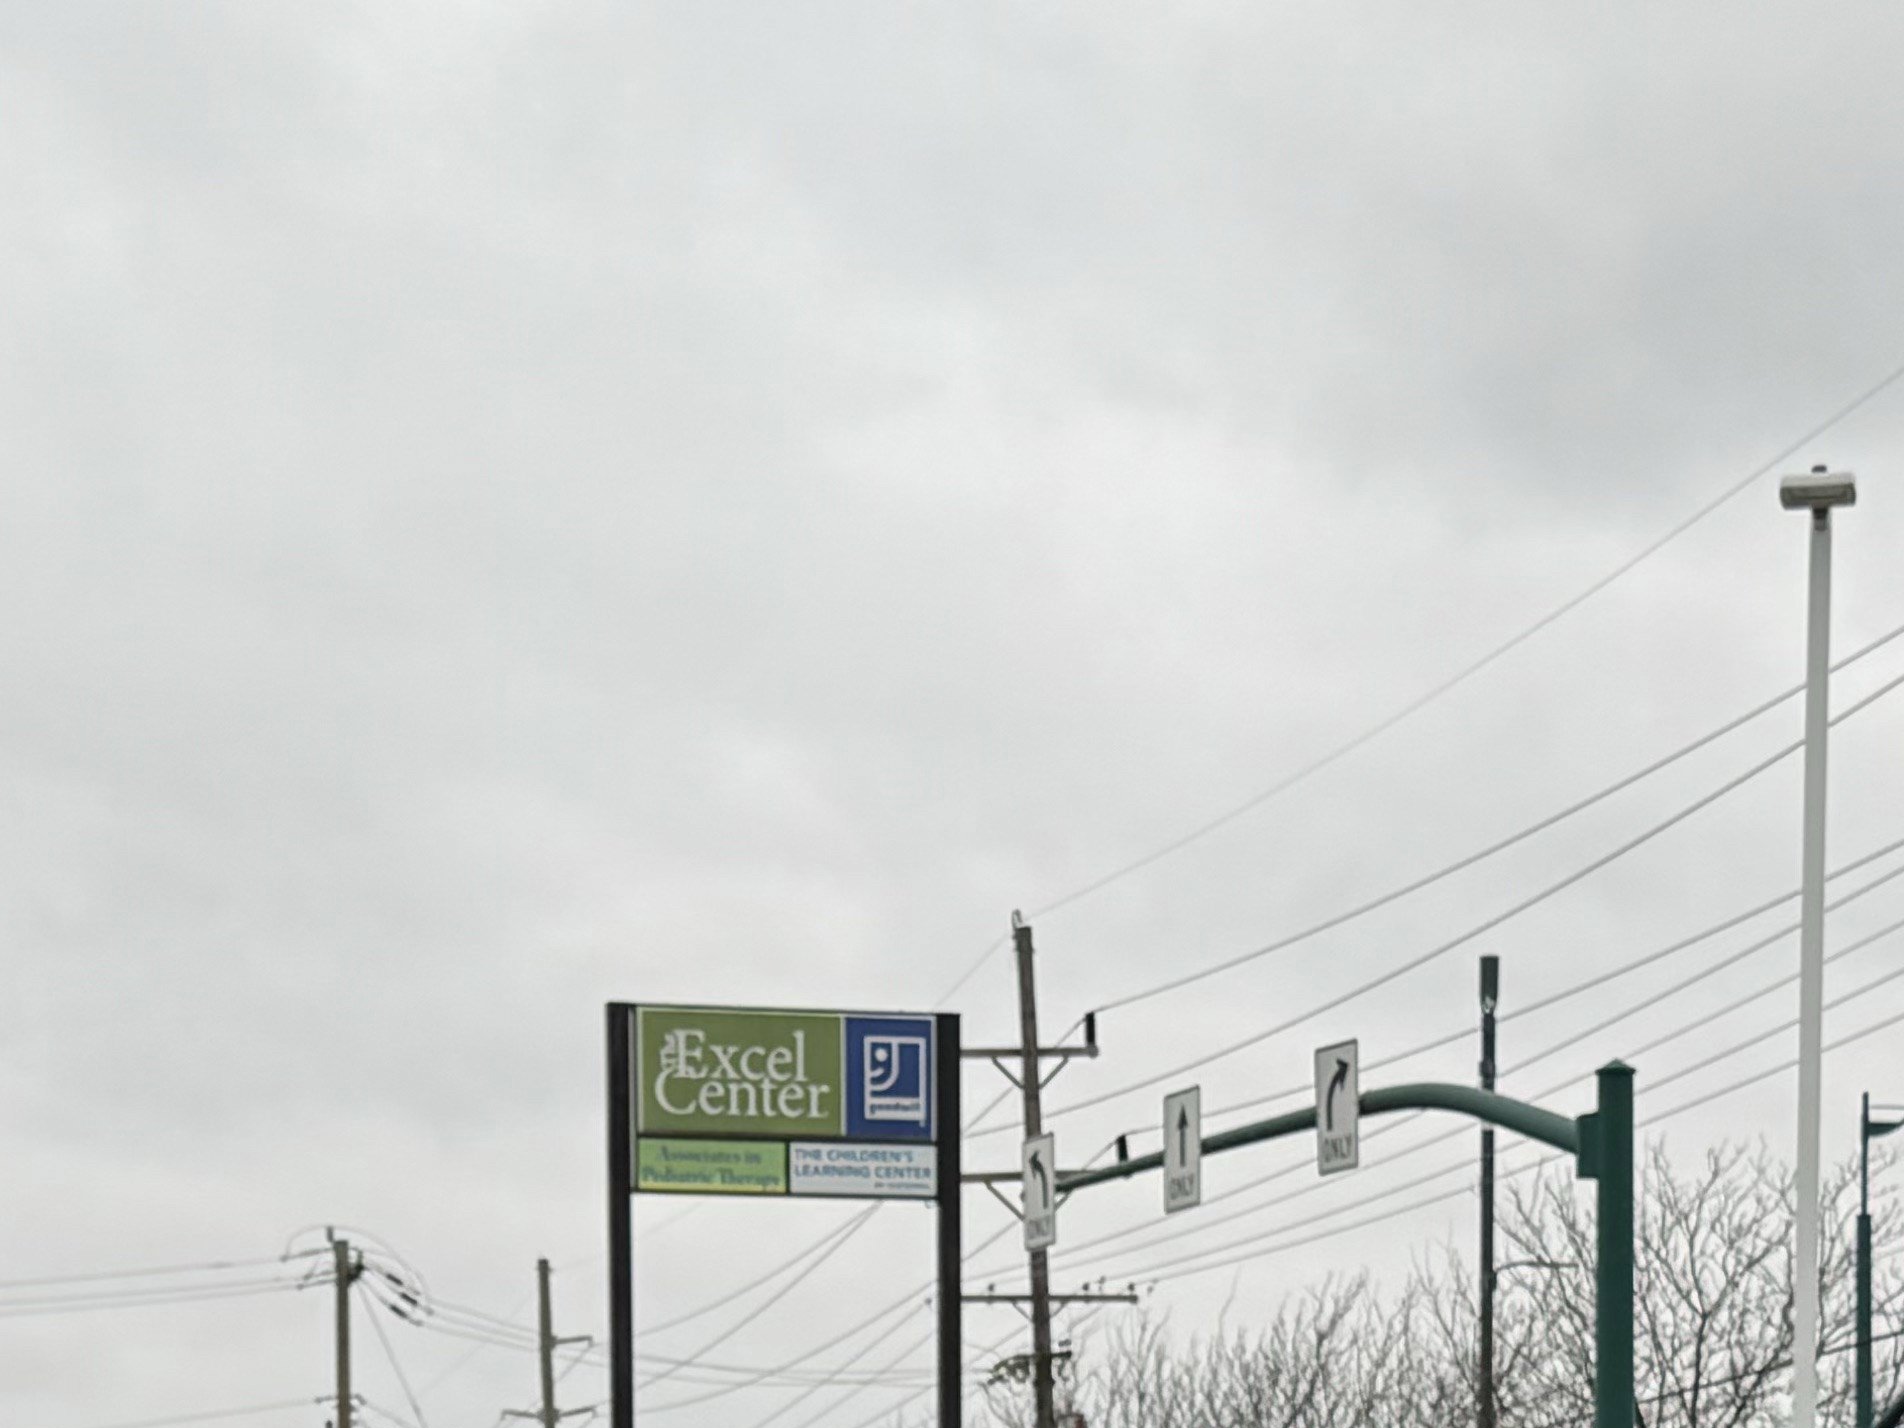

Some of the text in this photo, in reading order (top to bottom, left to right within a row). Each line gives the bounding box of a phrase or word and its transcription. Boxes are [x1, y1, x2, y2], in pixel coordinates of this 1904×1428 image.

[671, 1028, 807, 1083] Excel
[654, 1069, 831, 1119] Center
[795, 1165, 932, 1179] LEARNING CENTER
